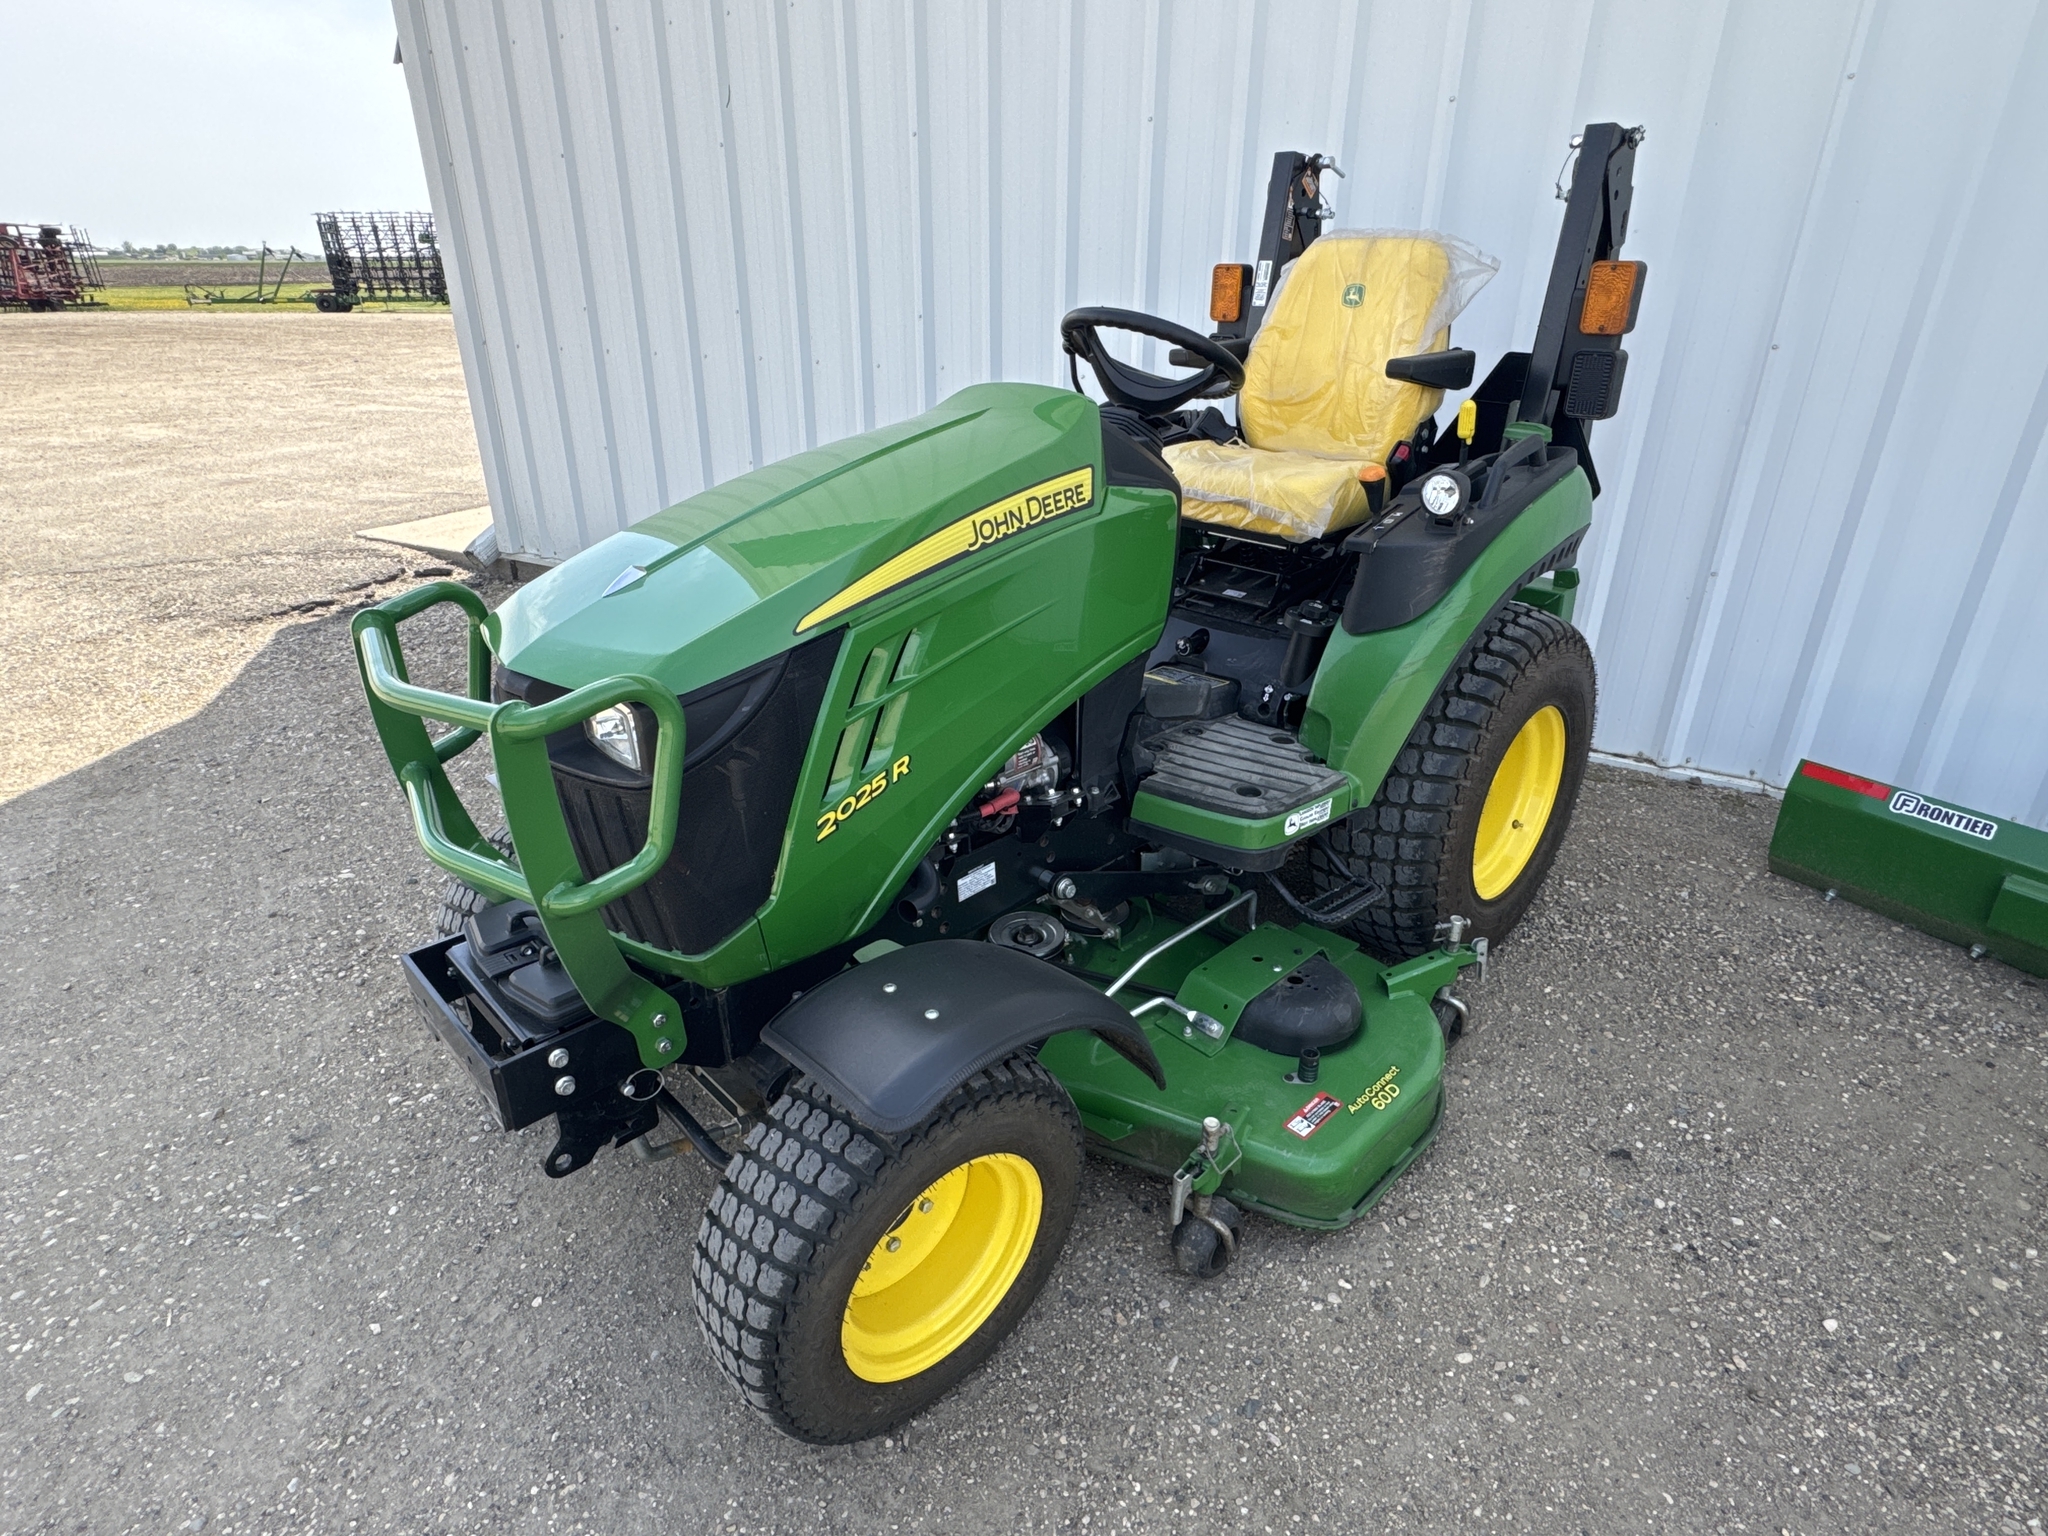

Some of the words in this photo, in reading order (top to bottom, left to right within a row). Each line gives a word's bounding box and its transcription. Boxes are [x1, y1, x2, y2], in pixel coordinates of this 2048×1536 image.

[967, 505, 1024, 549] JOHN
[1025, 483, 1087, 523] DEERE
[816, 770, 888, 842] 2025
[1891, 792, 1995, 838] FRONTIER
[1347, 1065, 1401, 1115] AutoConnect
[1371, 1083, 1400, 1111] 60D
